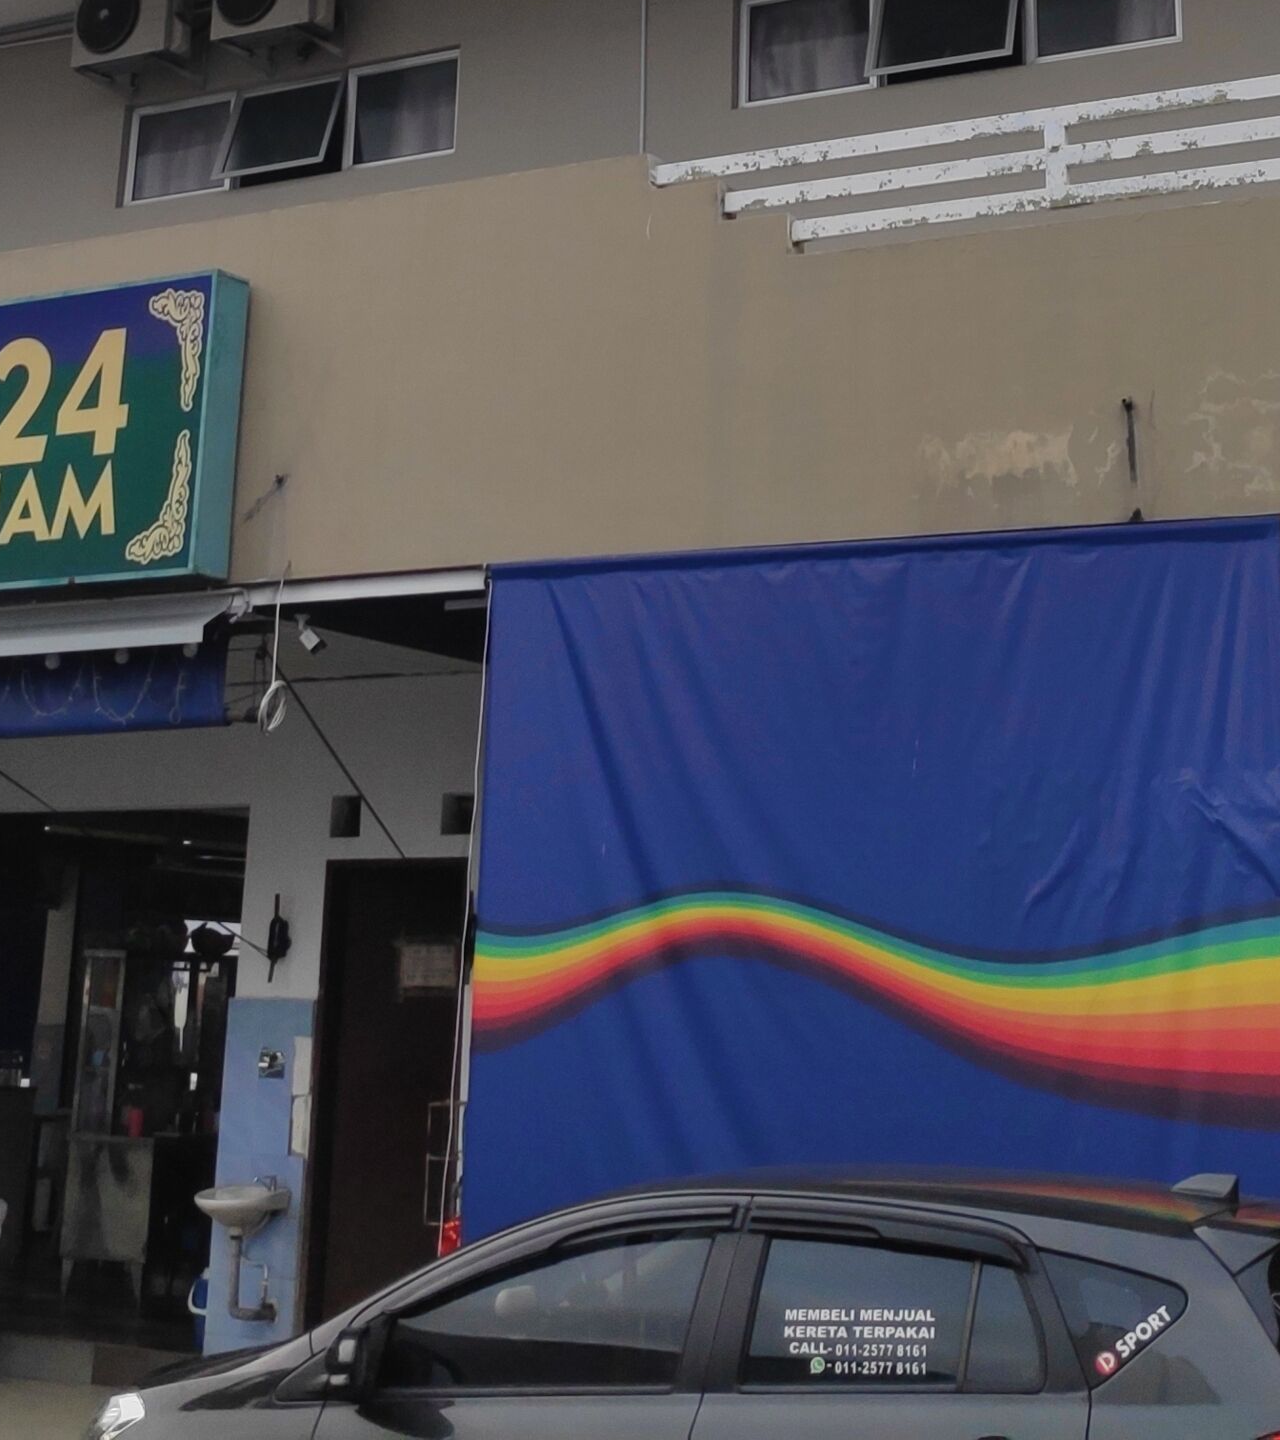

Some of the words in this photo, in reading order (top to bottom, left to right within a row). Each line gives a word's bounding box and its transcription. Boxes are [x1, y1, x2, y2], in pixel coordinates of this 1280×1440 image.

[785, 1309, 855, 1321] MEMBELI
[859, 1309, 935, 1322] MENJUAL
[784, 1326, 848, 1338] KERETA
[853, 1326, 935, 1339] TERPAKAI
[1115, 1305, 1171, 1359] SPORT
[897, 1345, 927, 1357] 8161
[896, 1362, 926, 1375] 8161
